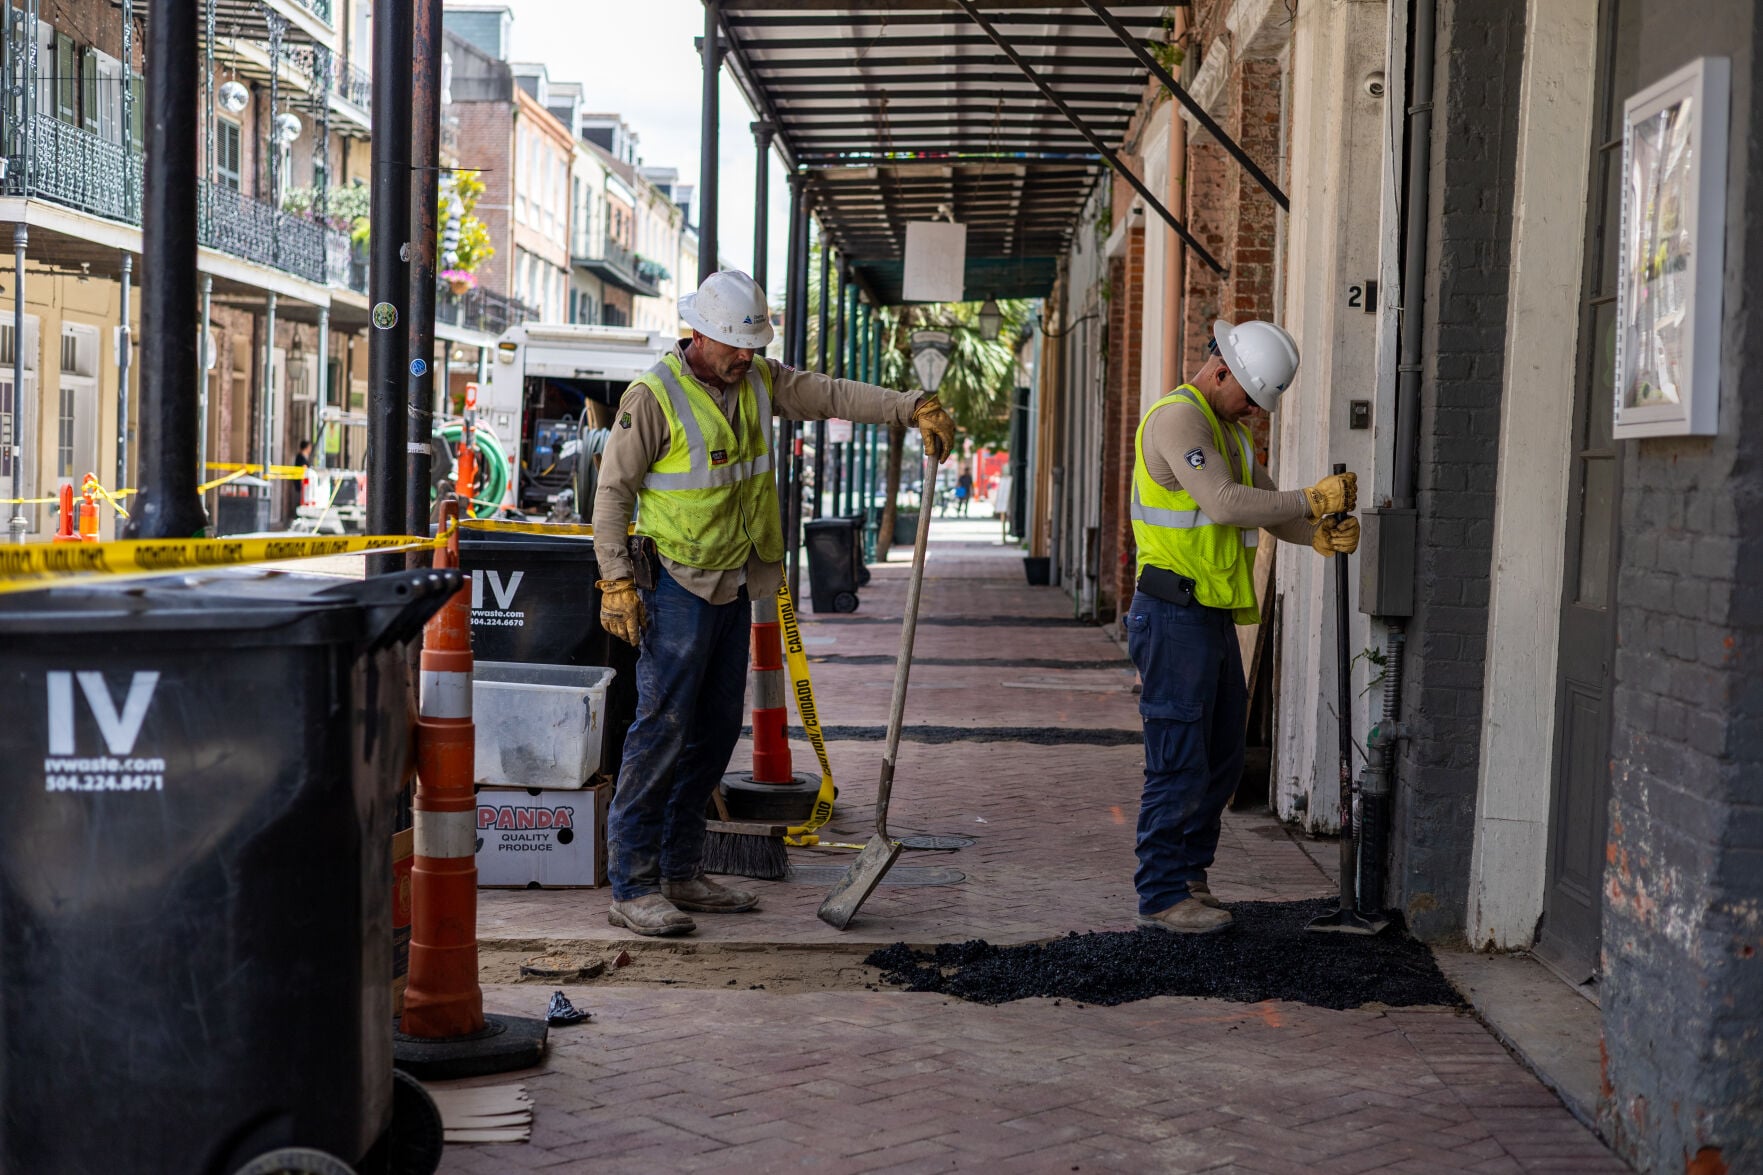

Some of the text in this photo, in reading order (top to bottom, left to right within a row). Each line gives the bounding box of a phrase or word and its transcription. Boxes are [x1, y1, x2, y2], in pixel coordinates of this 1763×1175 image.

[1349, 285, 1362, 308] 2
[471, 569, 525, 610] IV
[471, 609, 525, 618] vwaste.com
[47, 671, 161, 756] IV
[44, 756, 166, 773] ivwaste.com
[477, 805, 573, 830] PANDA
[498, 843, 553, 852] PRODUCE
[501, 833, 550, 842] QUALITY
